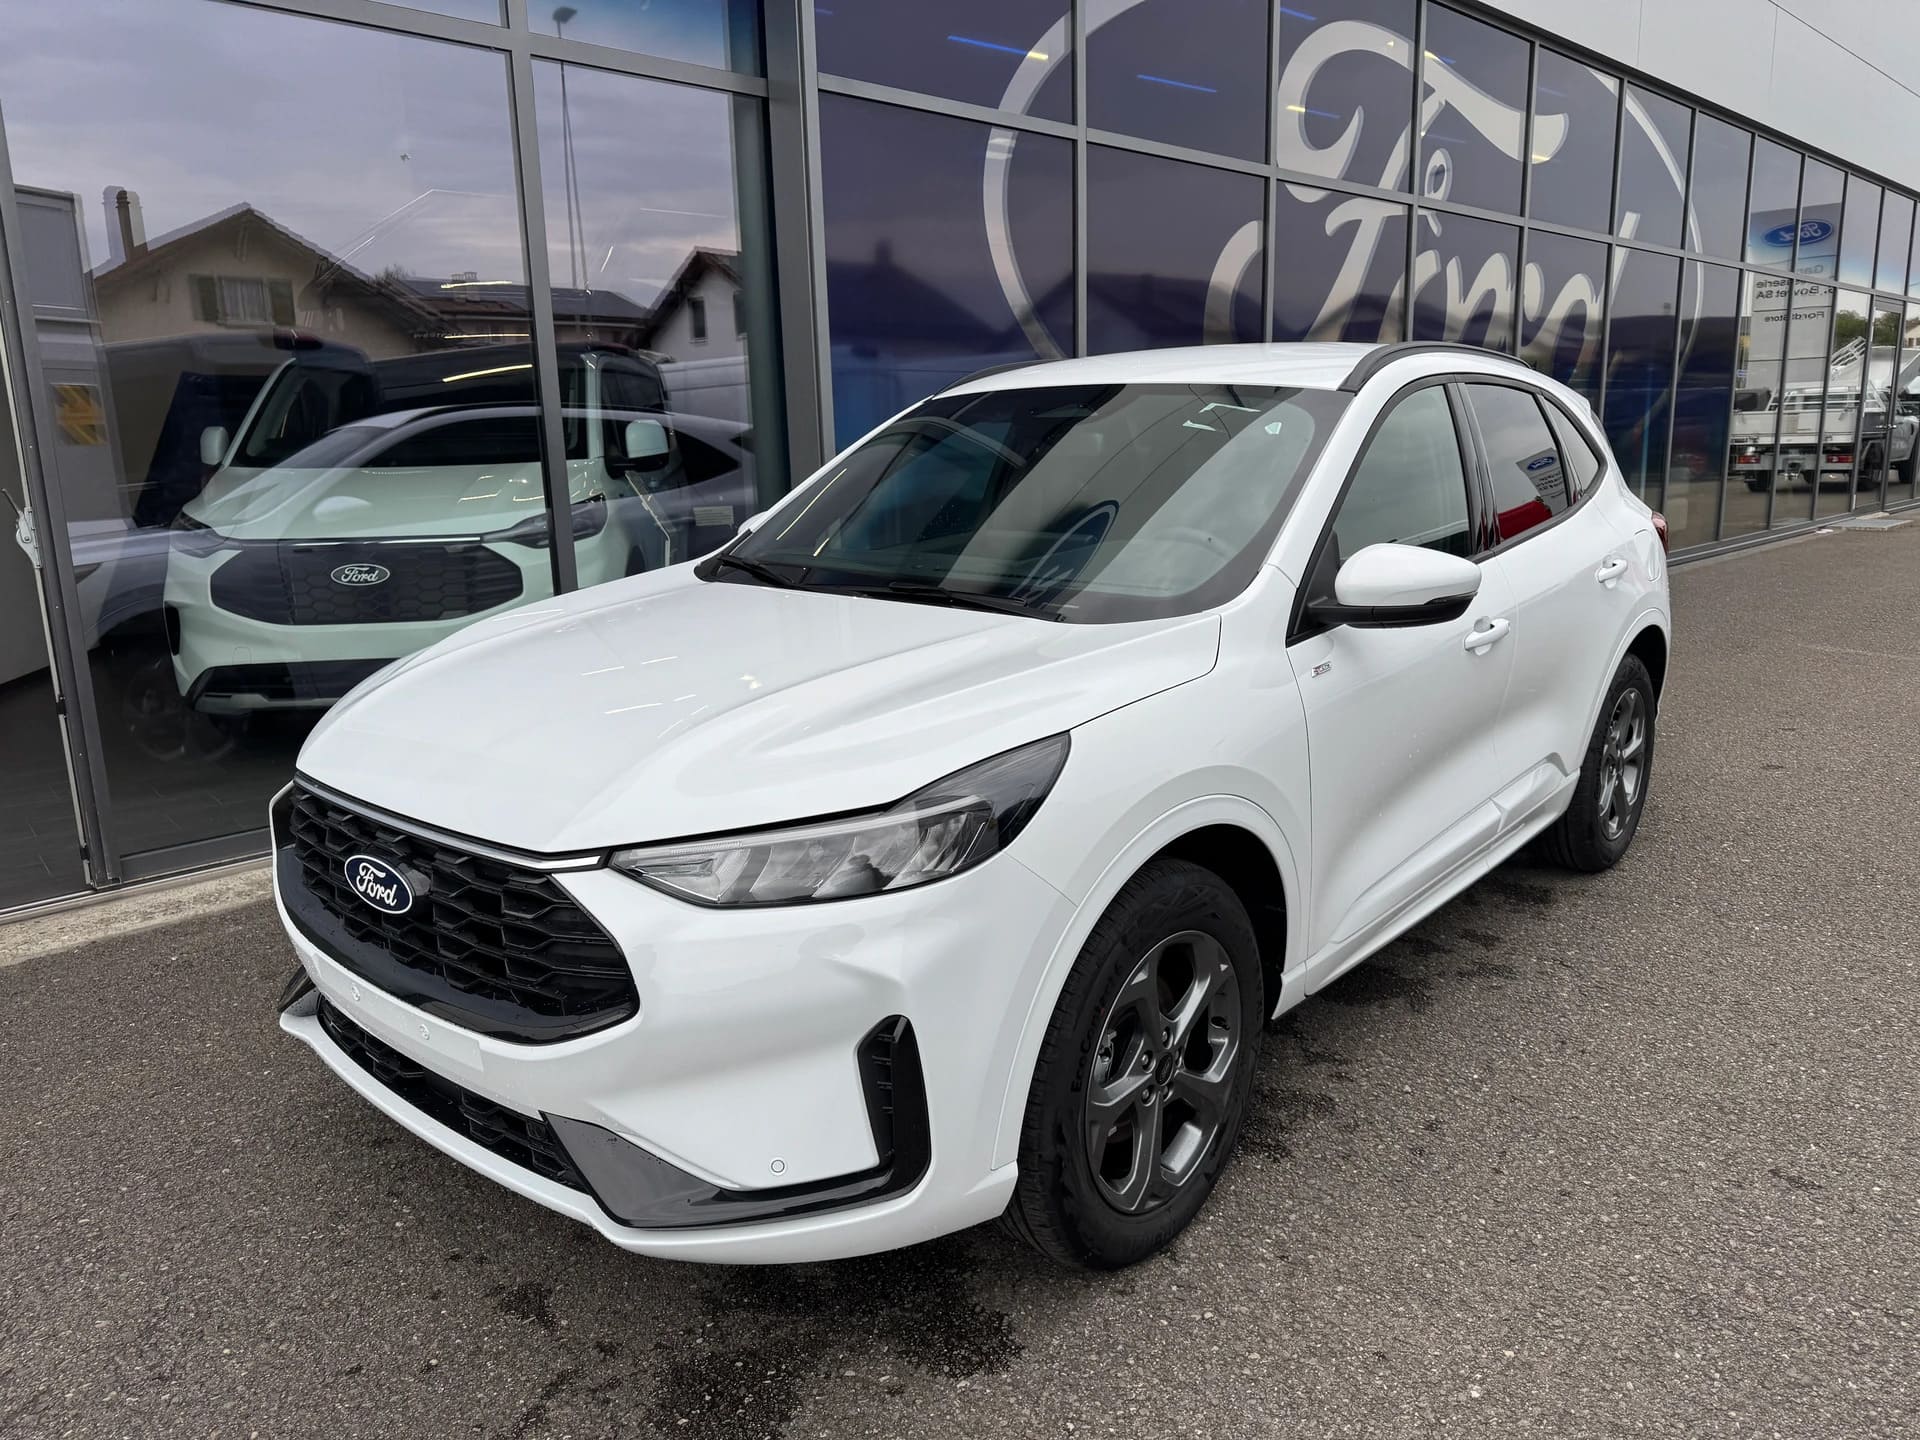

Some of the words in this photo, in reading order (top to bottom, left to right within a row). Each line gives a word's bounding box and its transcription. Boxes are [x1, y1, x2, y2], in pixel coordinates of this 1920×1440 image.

[1205, 20, 1638, 384] Ford
[341, 566, 379, 582] Ford
[356, 862, 397, 906] Ford
